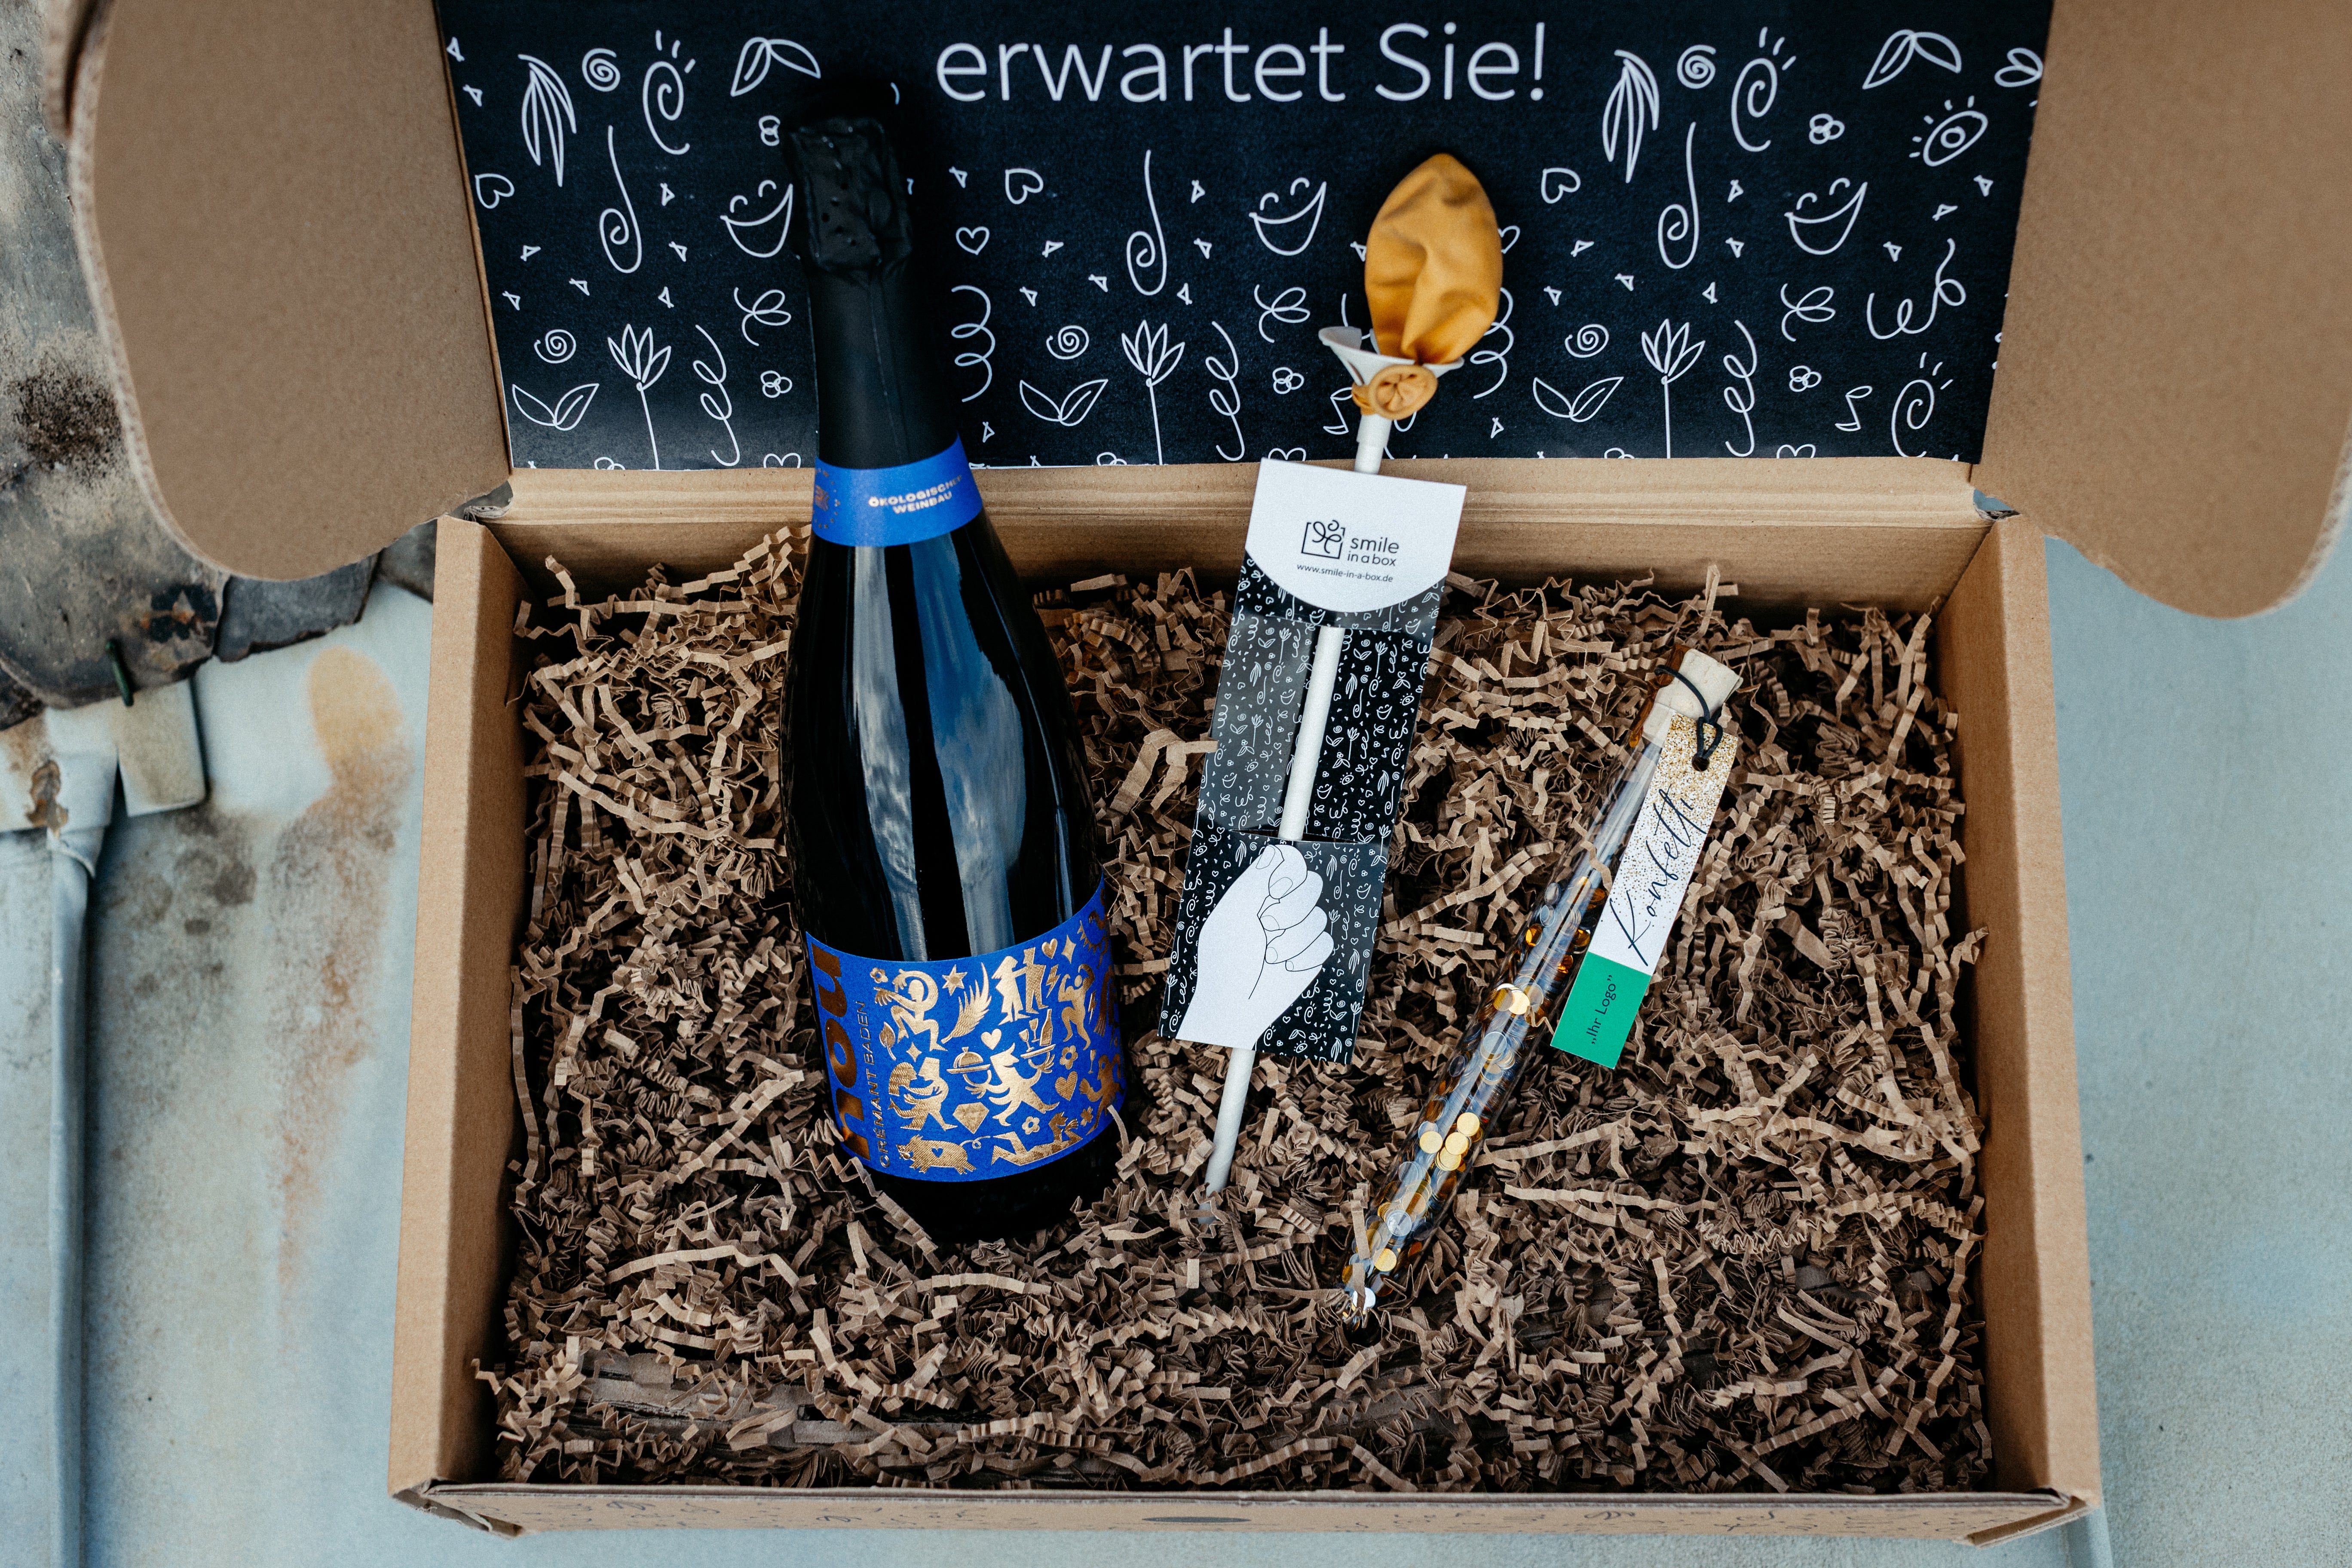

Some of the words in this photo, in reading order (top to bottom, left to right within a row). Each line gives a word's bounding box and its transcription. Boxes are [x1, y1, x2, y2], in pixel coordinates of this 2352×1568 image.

[936, 27, 1346, 102] erwartet
[1375, 21, 1546, 101] Sie!
[893, 491, 952, 514] WEINBAU
[1297, 564, 1393, 582] www.smile-in-a-box.de
[1350, 537, 1399, 554] smile
[1609, 784, 1708, 967] Konfetti
[855, 1001, 875, 1065] BADEN
[866, 1068, 890, 1168] CRÉMANT
